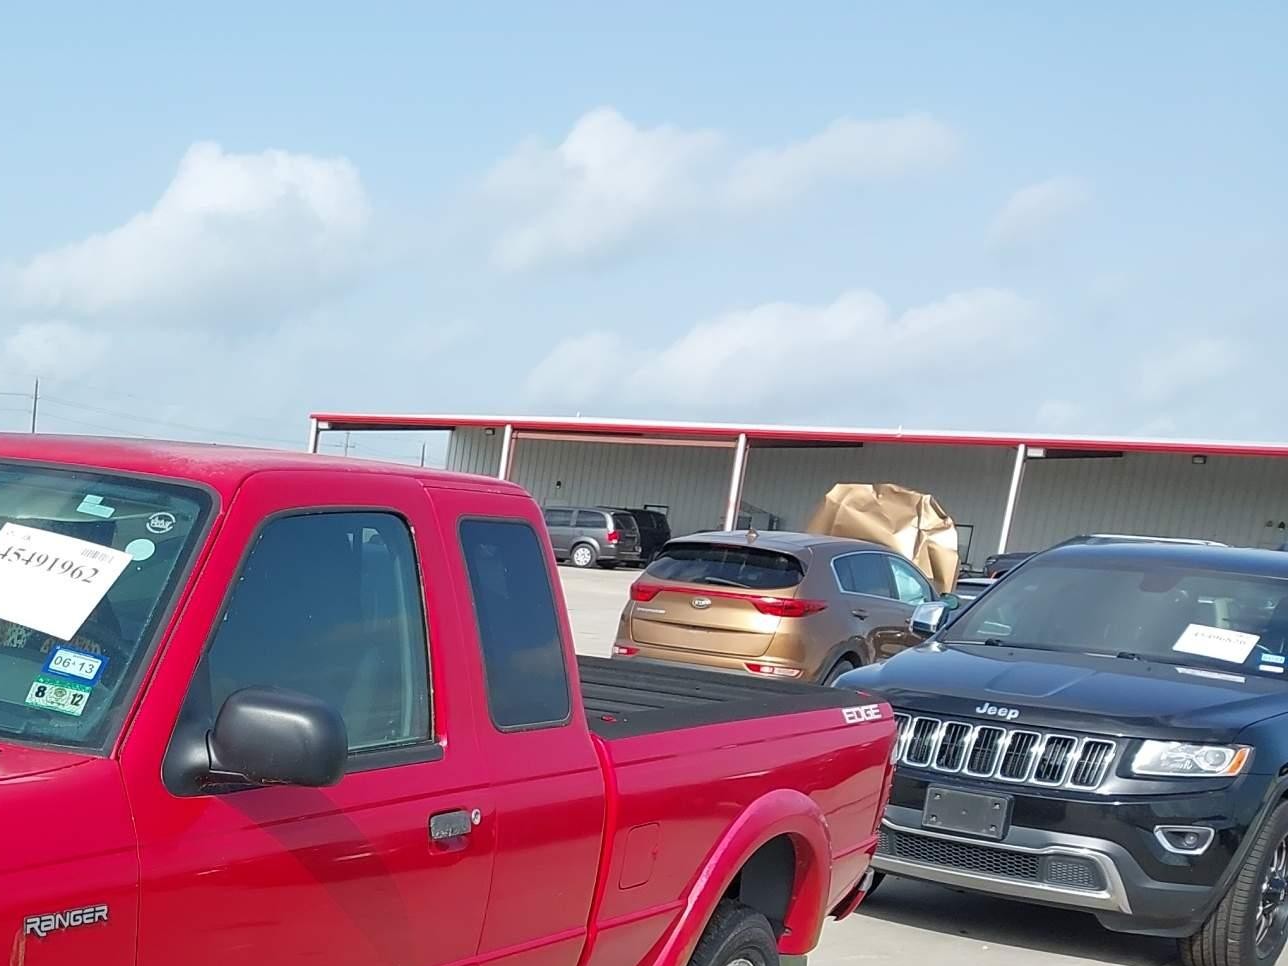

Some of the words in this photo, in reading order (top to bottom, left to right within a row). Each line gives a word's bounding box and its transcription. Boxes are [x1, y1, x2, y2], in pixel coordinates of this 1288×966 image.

[53, 655, 72, 669] 06
[78, 661, 95, 675] 13
[34, 685, 48, 698] 8
[70, 692, 84, 707] 12
[842, 704, 882, 724] EDGE
[975, 702, 1020, 721] Jeep
